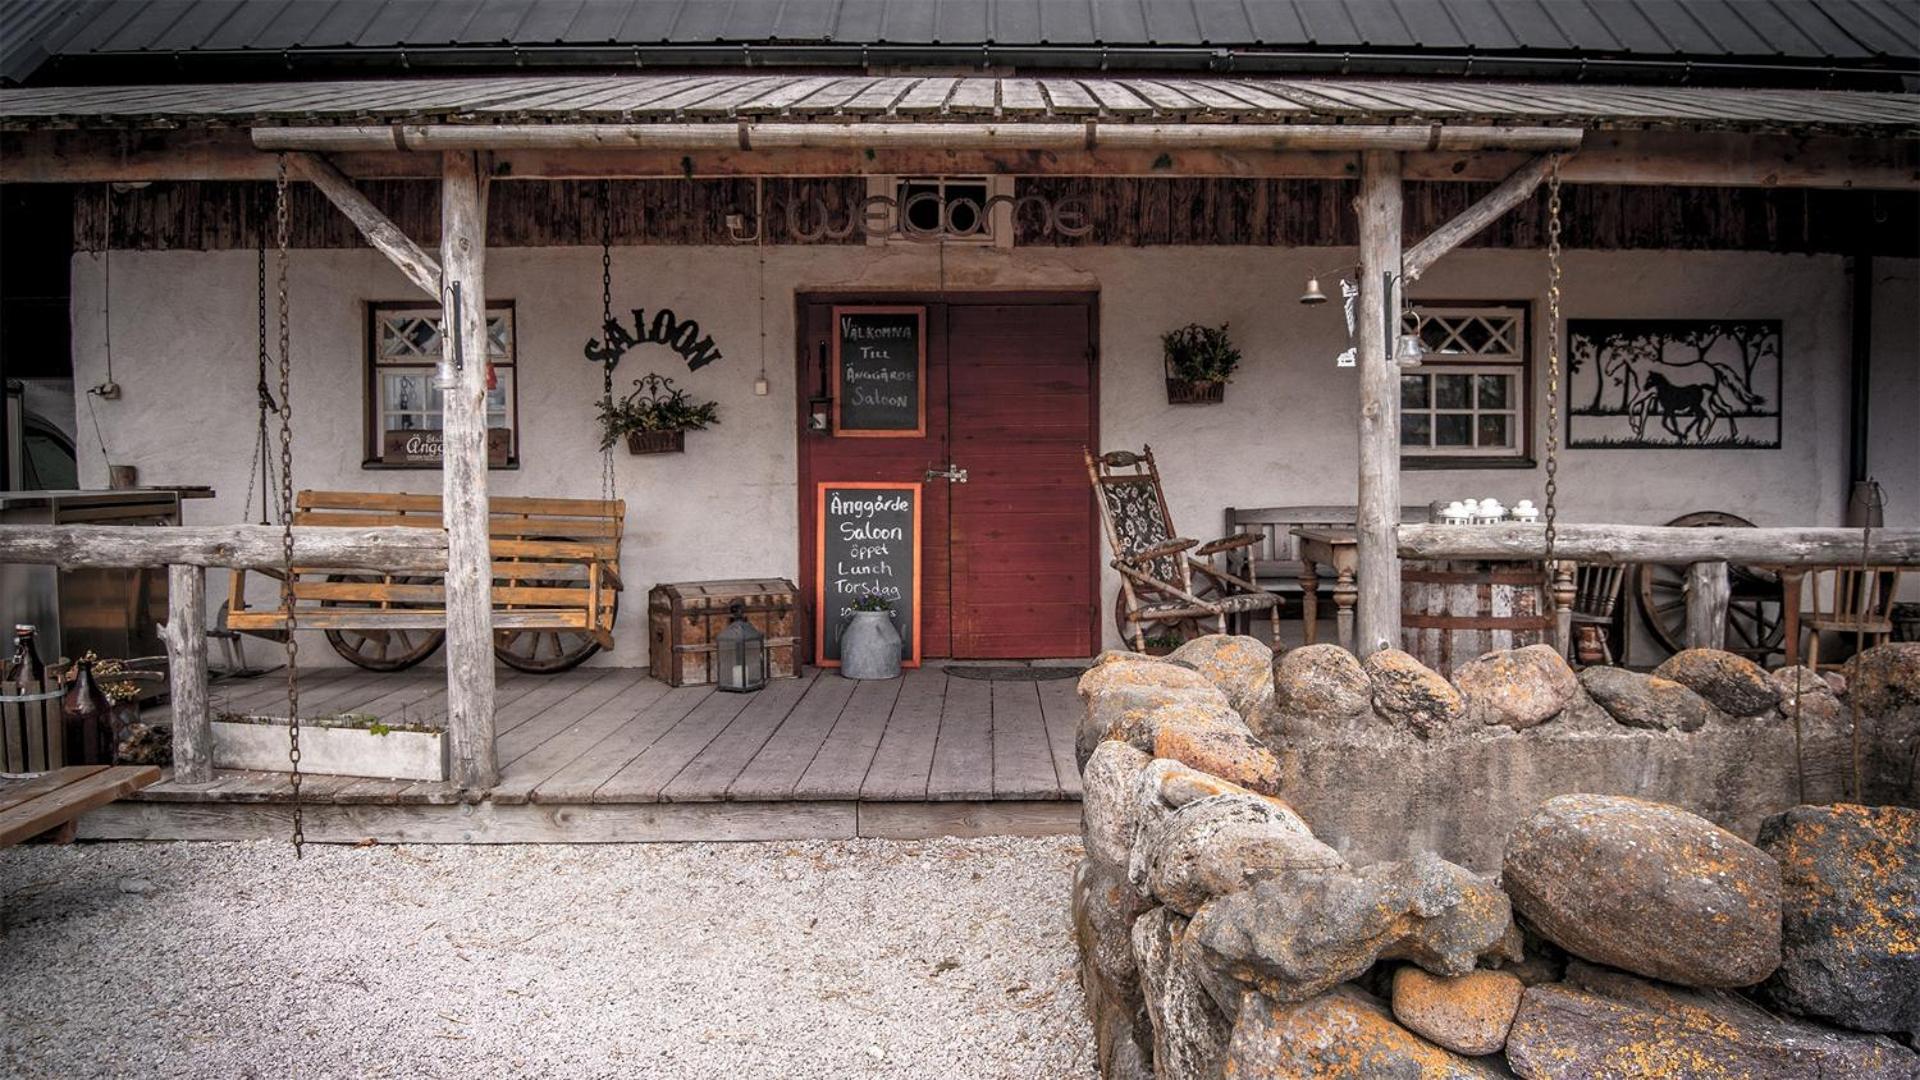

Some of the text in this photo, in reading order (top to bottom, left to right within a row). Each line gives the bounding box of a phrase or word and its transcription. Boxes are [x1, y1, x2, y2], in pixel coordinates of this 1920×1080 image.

[584, 309, 723, 372] SALOON
[830, 492, 909, 518] Änggårde
[840, 521, 903, 541] Saloon
[838, 561, 893, 577] Lunch
[834, 579, 901, 601] Torsdag
